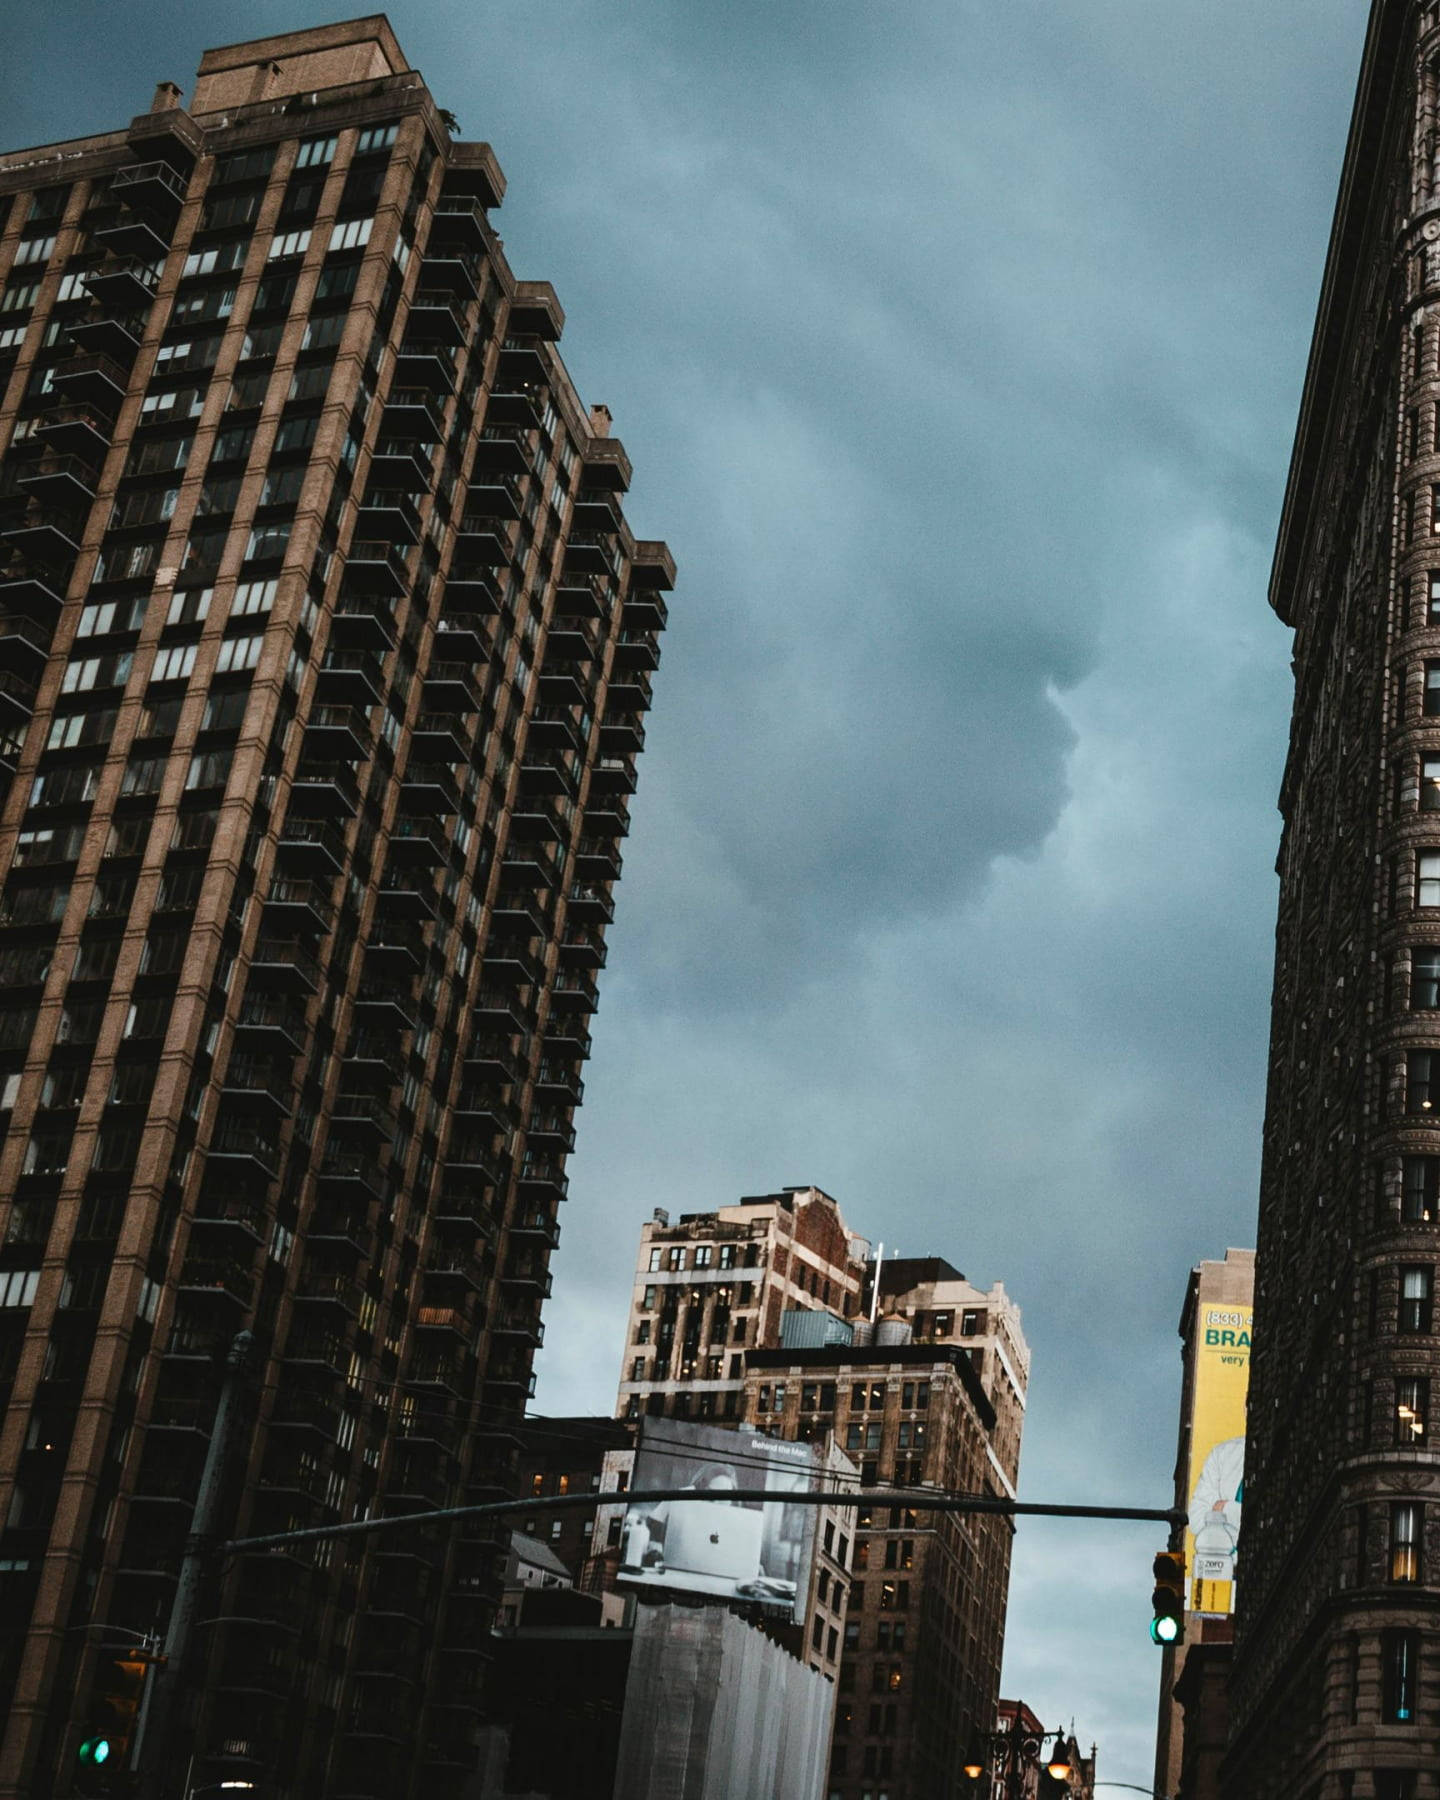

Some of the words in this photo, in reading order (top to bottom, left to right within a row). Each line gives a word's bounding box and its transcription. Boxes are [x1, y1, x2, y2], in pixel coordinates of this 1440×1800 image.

[1221, 1356, 1245, 1368] very
[752, 1439, 778, 1453] Behind
[778, 1445, 790, 1455] the
[790, 1446, 807, 1458] Mac
